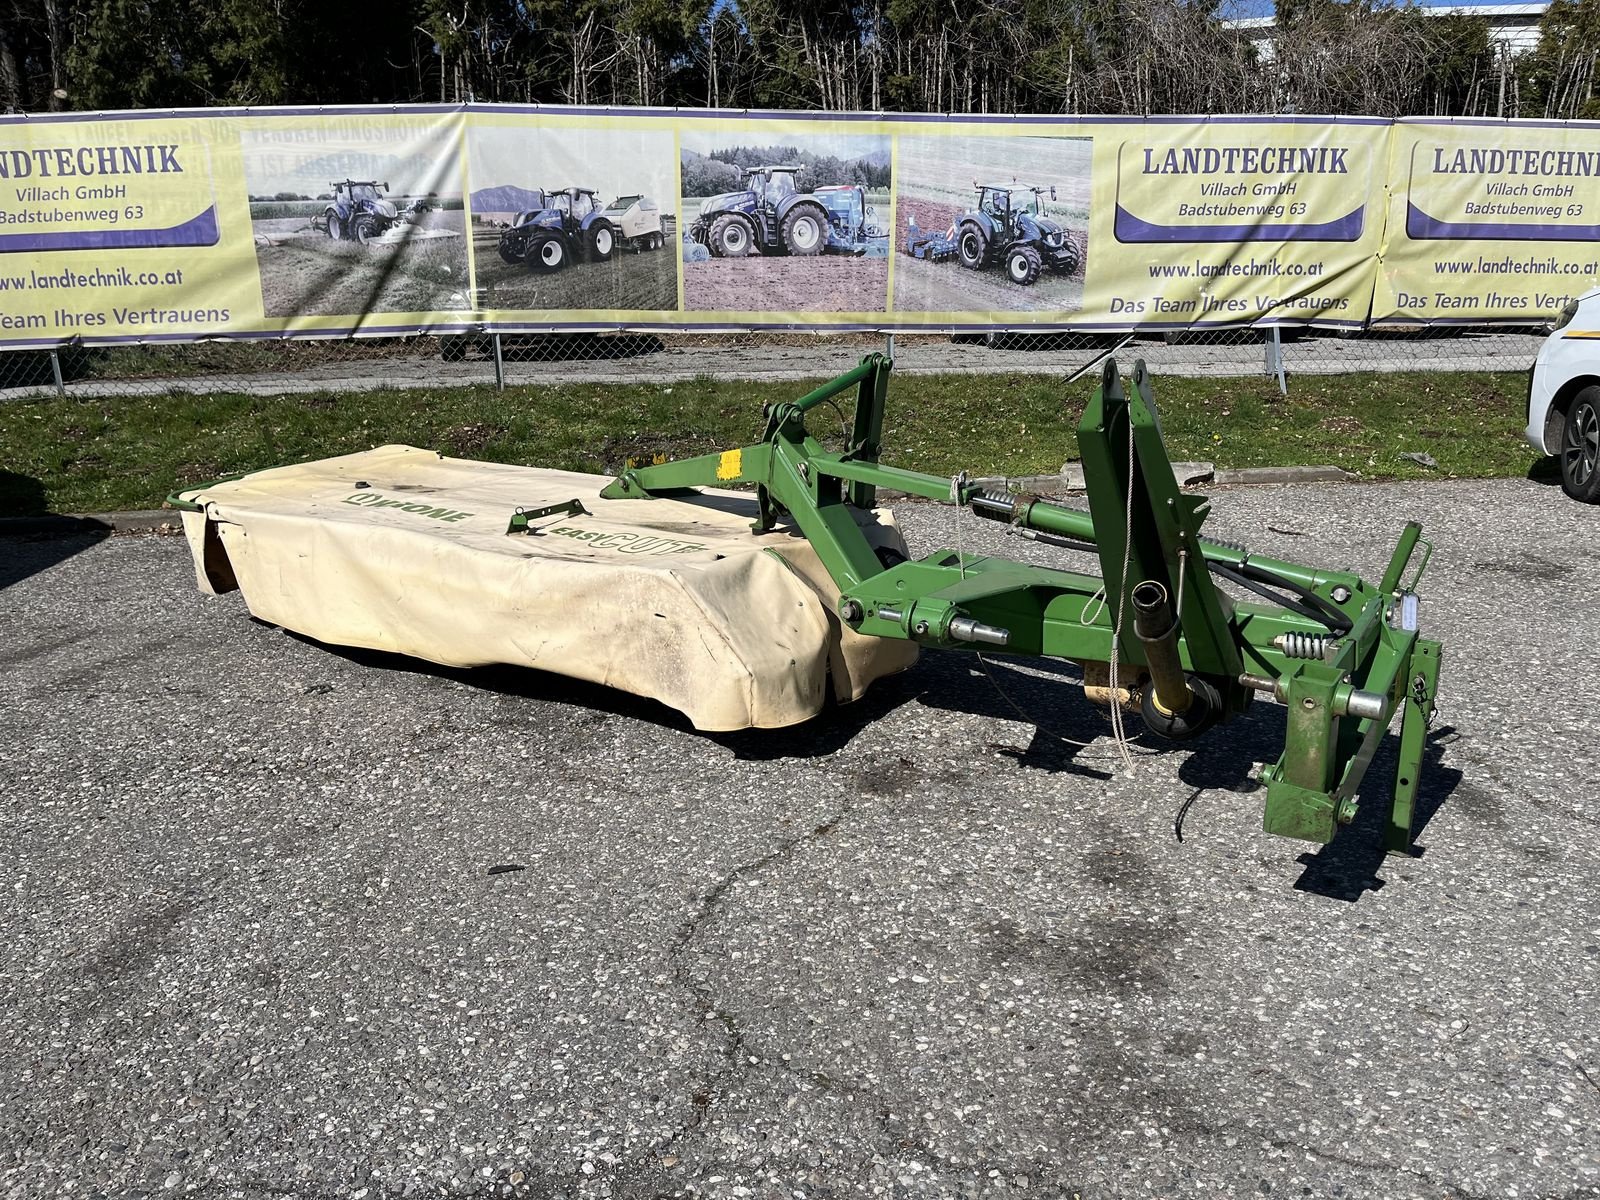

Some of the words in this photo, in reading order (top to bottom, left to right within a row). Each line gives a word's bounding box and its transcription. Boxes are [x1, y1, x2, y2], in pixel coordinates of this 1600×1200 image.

[1142, 147, 1349, 175] LANDTECHNIK
[16, 186, 70, 202] Villach
[75, 184, 126, 200] GmbH
[1200, 183, 1247, 196] Villach
[1252, 182, 1297, 196] GmbH
[1486, 182, 1528, 196] Villach
[1532, 184, 1574, 198] GmbH
[0, 208, 118, 224] Badstubenweg
[124, 205, 144, 220] 63
[1178, 203, 1285, 218] Badstubenweg
[1289, 202, 1306, 215] 63
[1465, 202, 1562, 219] Badstubenweg
[1566, 204, 1583, 217] 63
[1149, 258, 1323, 278] www.landtechnik.co.at
[1434, 255, 1599, 275] www.landtechnik.co.at
[1110, 297, 1145, 313] Das
[1153, 297, 1196, 313] Team
[1203, 295, 1247, 312] Ihres
[1255, 295, 1349, 311] Vetrauens
[1397, 292, 1428, 309] Das
[1434, 293, 1479, 309] Team
[1485, 292, 1528, 309] Ihres
[1535, 293, 1577, 309] Vert
[54, 308, 107, 327] Ihres
[112, 306, 230, 324] Vertrauens
